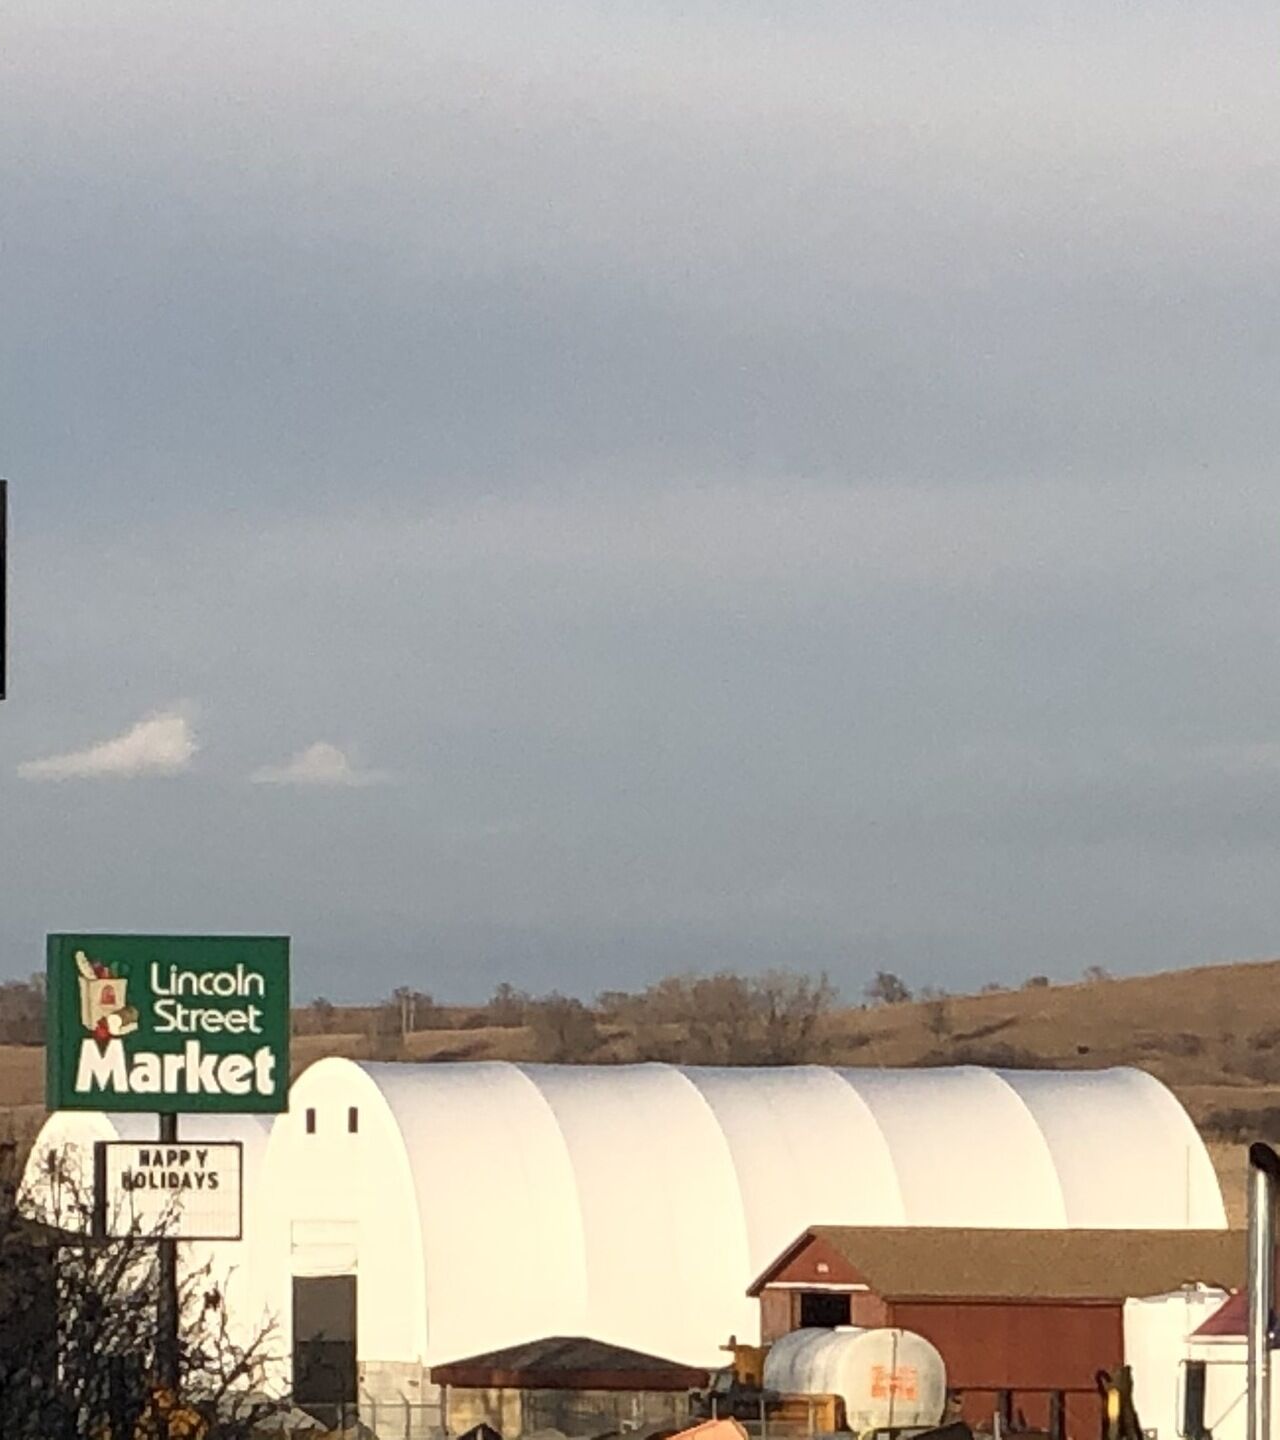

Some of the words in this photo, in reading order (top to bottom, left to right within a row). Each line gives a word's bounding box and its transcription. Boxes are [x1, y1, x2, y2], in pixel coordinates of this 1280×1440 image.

[151, 962, 265, 998] Lincoln
[152, 998, 264, 1034] Street
[74, 1037, 276, 1096] Market
[139, 1149, 208, 1168] HAPPY
[121, 1171, 219, 1190] HOLIDAYS
